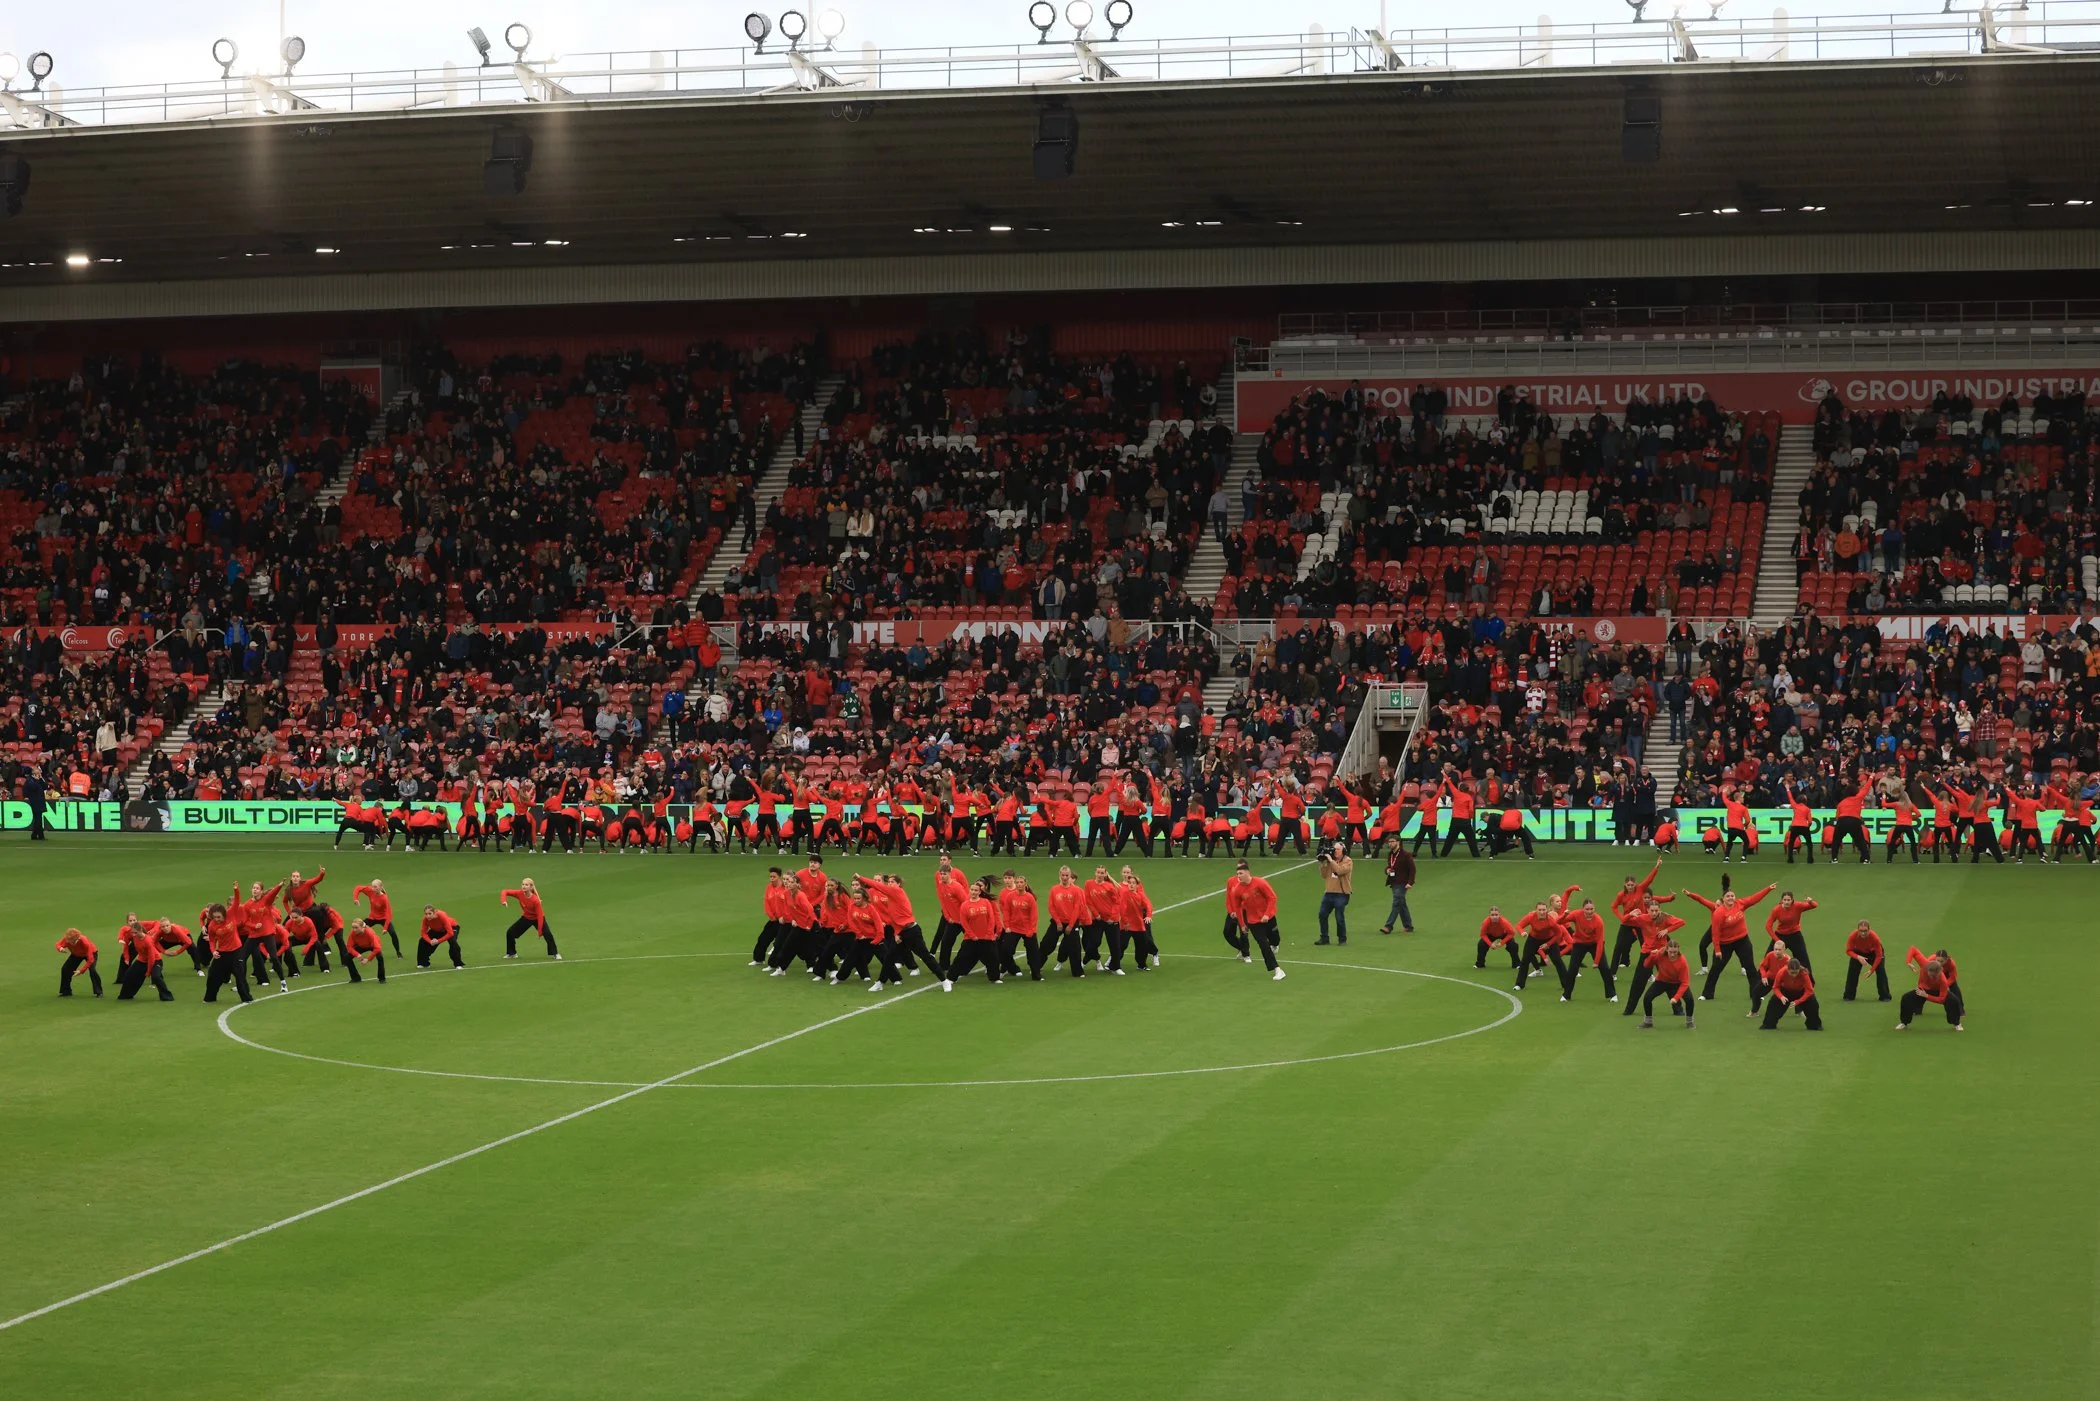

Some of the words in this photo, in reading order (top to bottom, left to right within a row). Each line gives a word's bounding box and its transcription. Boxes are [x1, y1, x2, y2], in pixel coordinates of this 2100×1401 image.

[1446, 384, 1608, 408] INDSTRIAL
[1614, 383, 1652, 405] UK
[1847, 379, 1947, 401] GROUP
[0, 801, 121, 830] DNITE
[184, 808, 264, 825] BUILT
